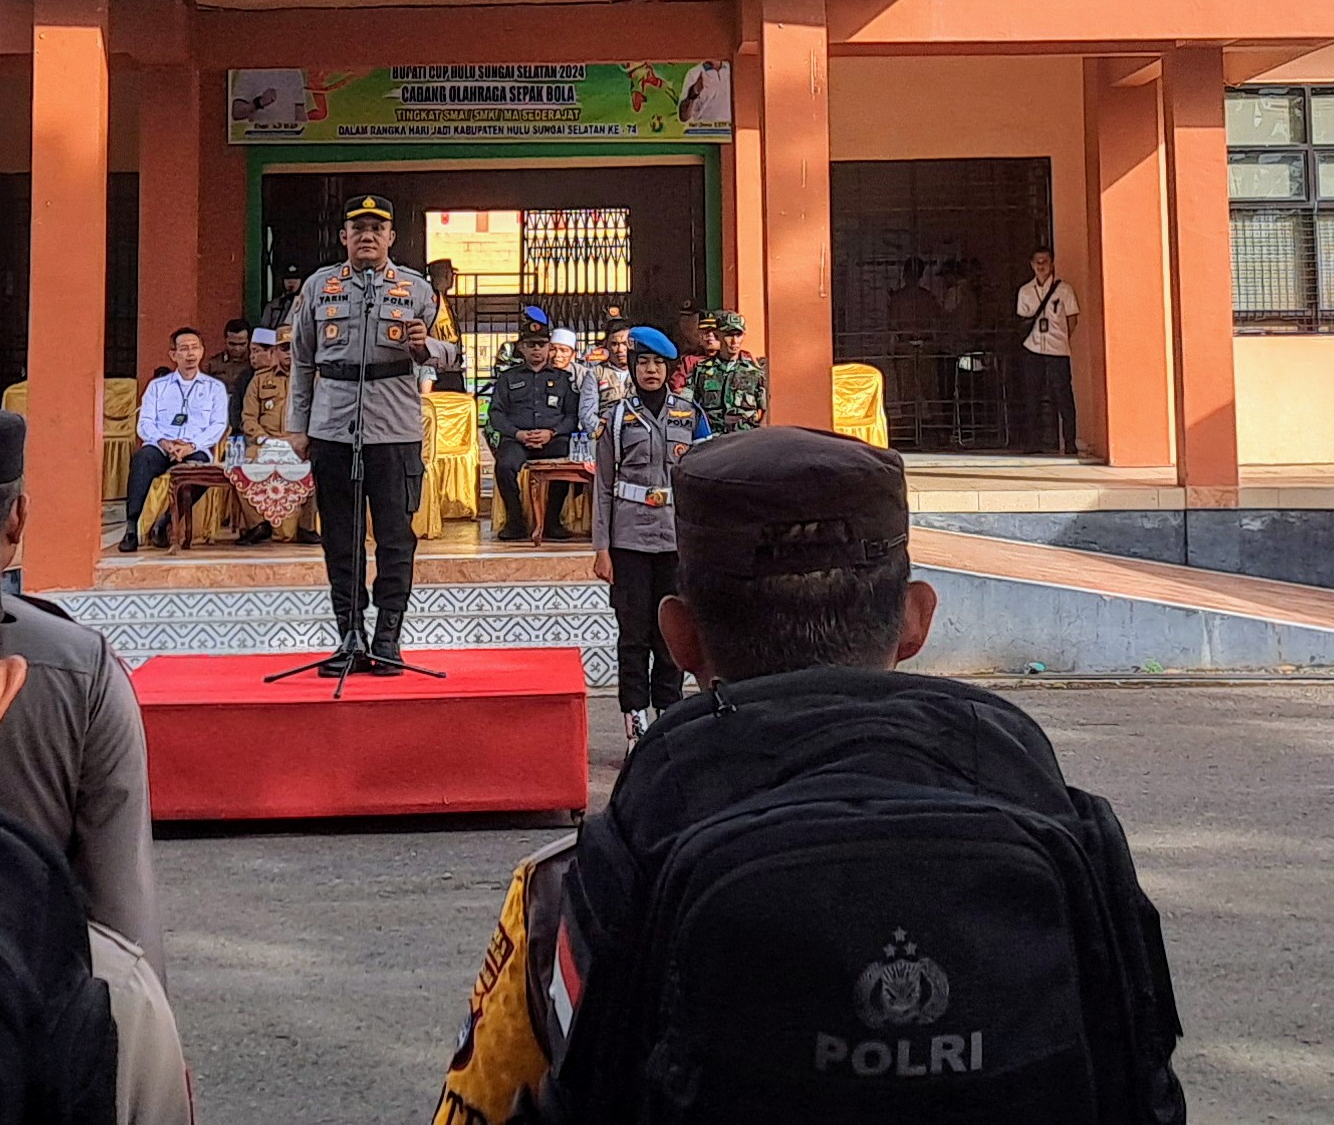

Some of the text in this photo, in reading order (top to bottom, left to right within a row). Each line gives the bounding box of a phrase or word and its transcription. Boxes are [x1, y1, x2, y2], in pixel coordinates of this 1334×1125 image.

[392, 64, 585, 80] BUPATI CUP HULU SUNGAI SELATAN 2024
[401, 85, 575, 103] CABANG OLAHRAGA SEPAK BOLA
[396, 109, 442, 122] TINGKAT
[522, 108, 581, 121] SEDERAJAT
[338, 125, 367, 136] DALAM
[369, 125, 407, 136] RANGKA
[408, 125, 430, 136] HARI
[430, 125, 451, 136] JADI
[453, 125, 504, 136] KABUPATEN
[506, 125, 530, 135] HULU
[532, 125, 565, 135] SUNGAI
[567, 125, 605, 135] SELATAN
[607, 124, 620, 135] KE
[383, 296, 414, 308] POLRI
[816, 1031, 983, 1075] POLRI
